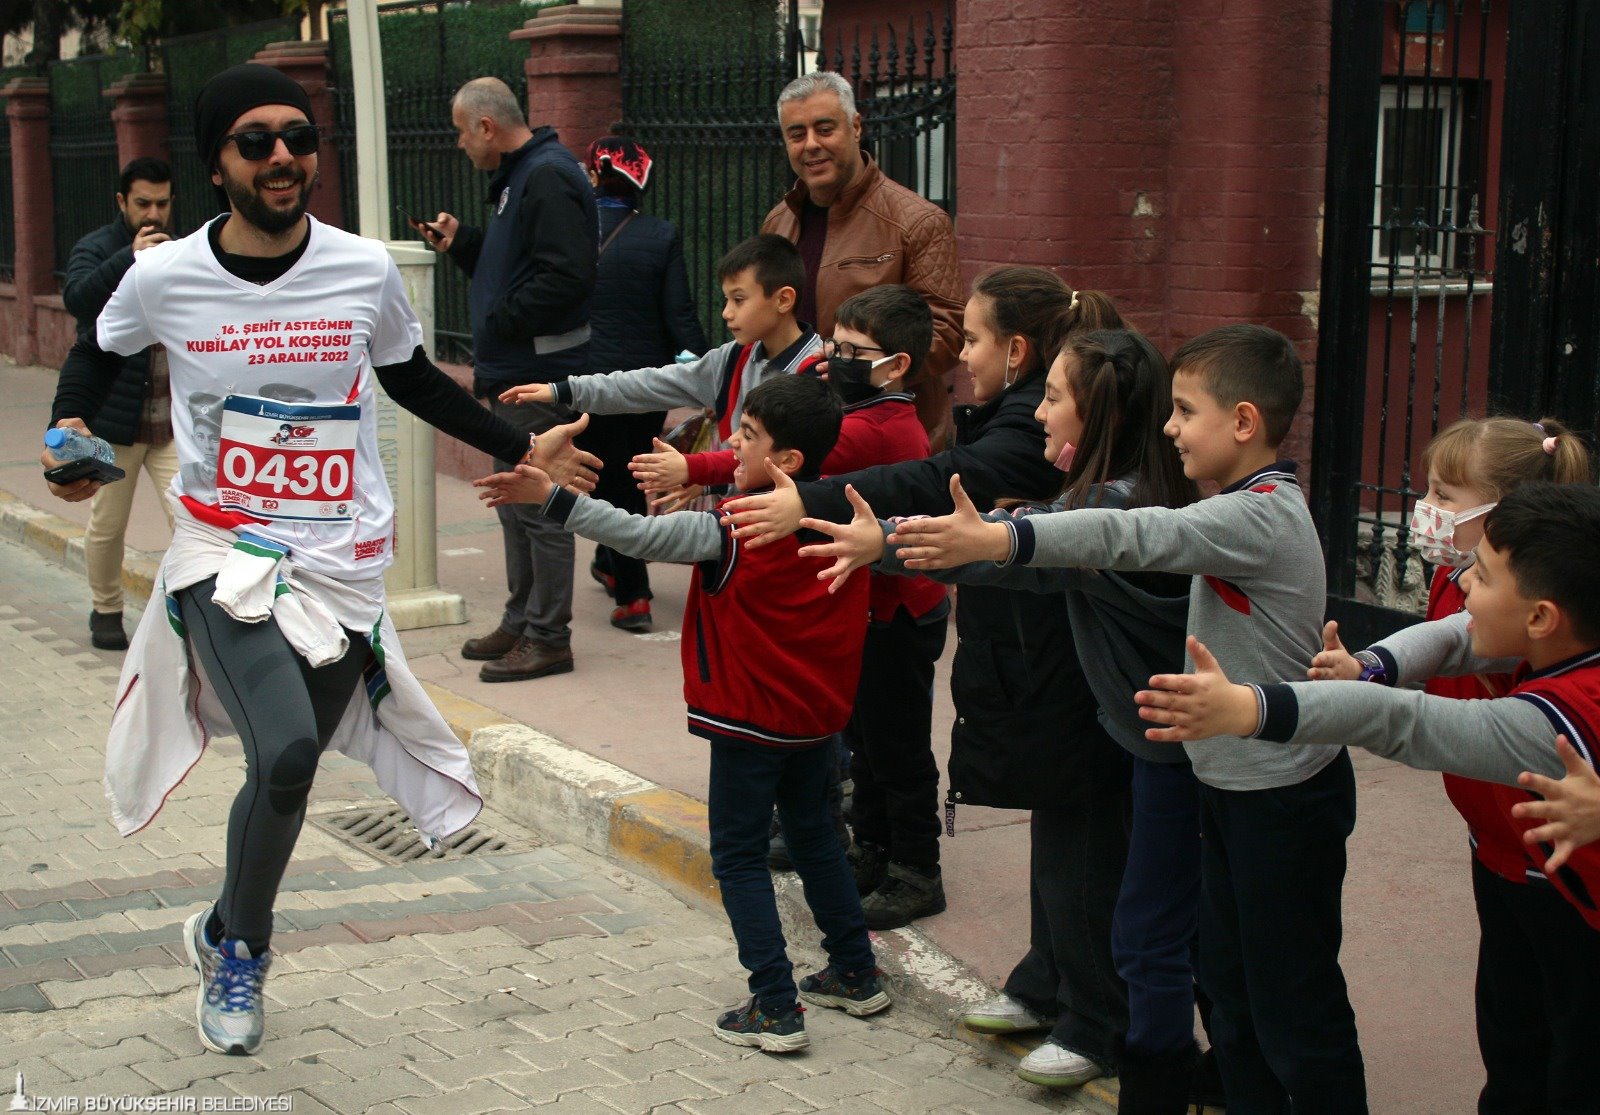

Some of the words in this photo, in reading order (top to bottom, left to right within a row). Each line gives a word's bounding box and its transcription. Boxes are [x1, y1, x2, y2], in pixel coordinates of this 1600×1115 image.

[221, 324, 239, 335] 16.
[243, 319, 281, 335] ŞEHİT
[284, 318, 353, 331] ASTEĞMEN
[186, 335, 250, 352] KUBİLAY
[253, 336, 285, 349] YOL
[288, 335, 352, 349] KOŞUSU
[248, 353, 265, 365] 23
[268, 352, 317, 363] ARALIK
[320, 350, 349, 362] 2022
[223, 446, 349, 497] 0430
